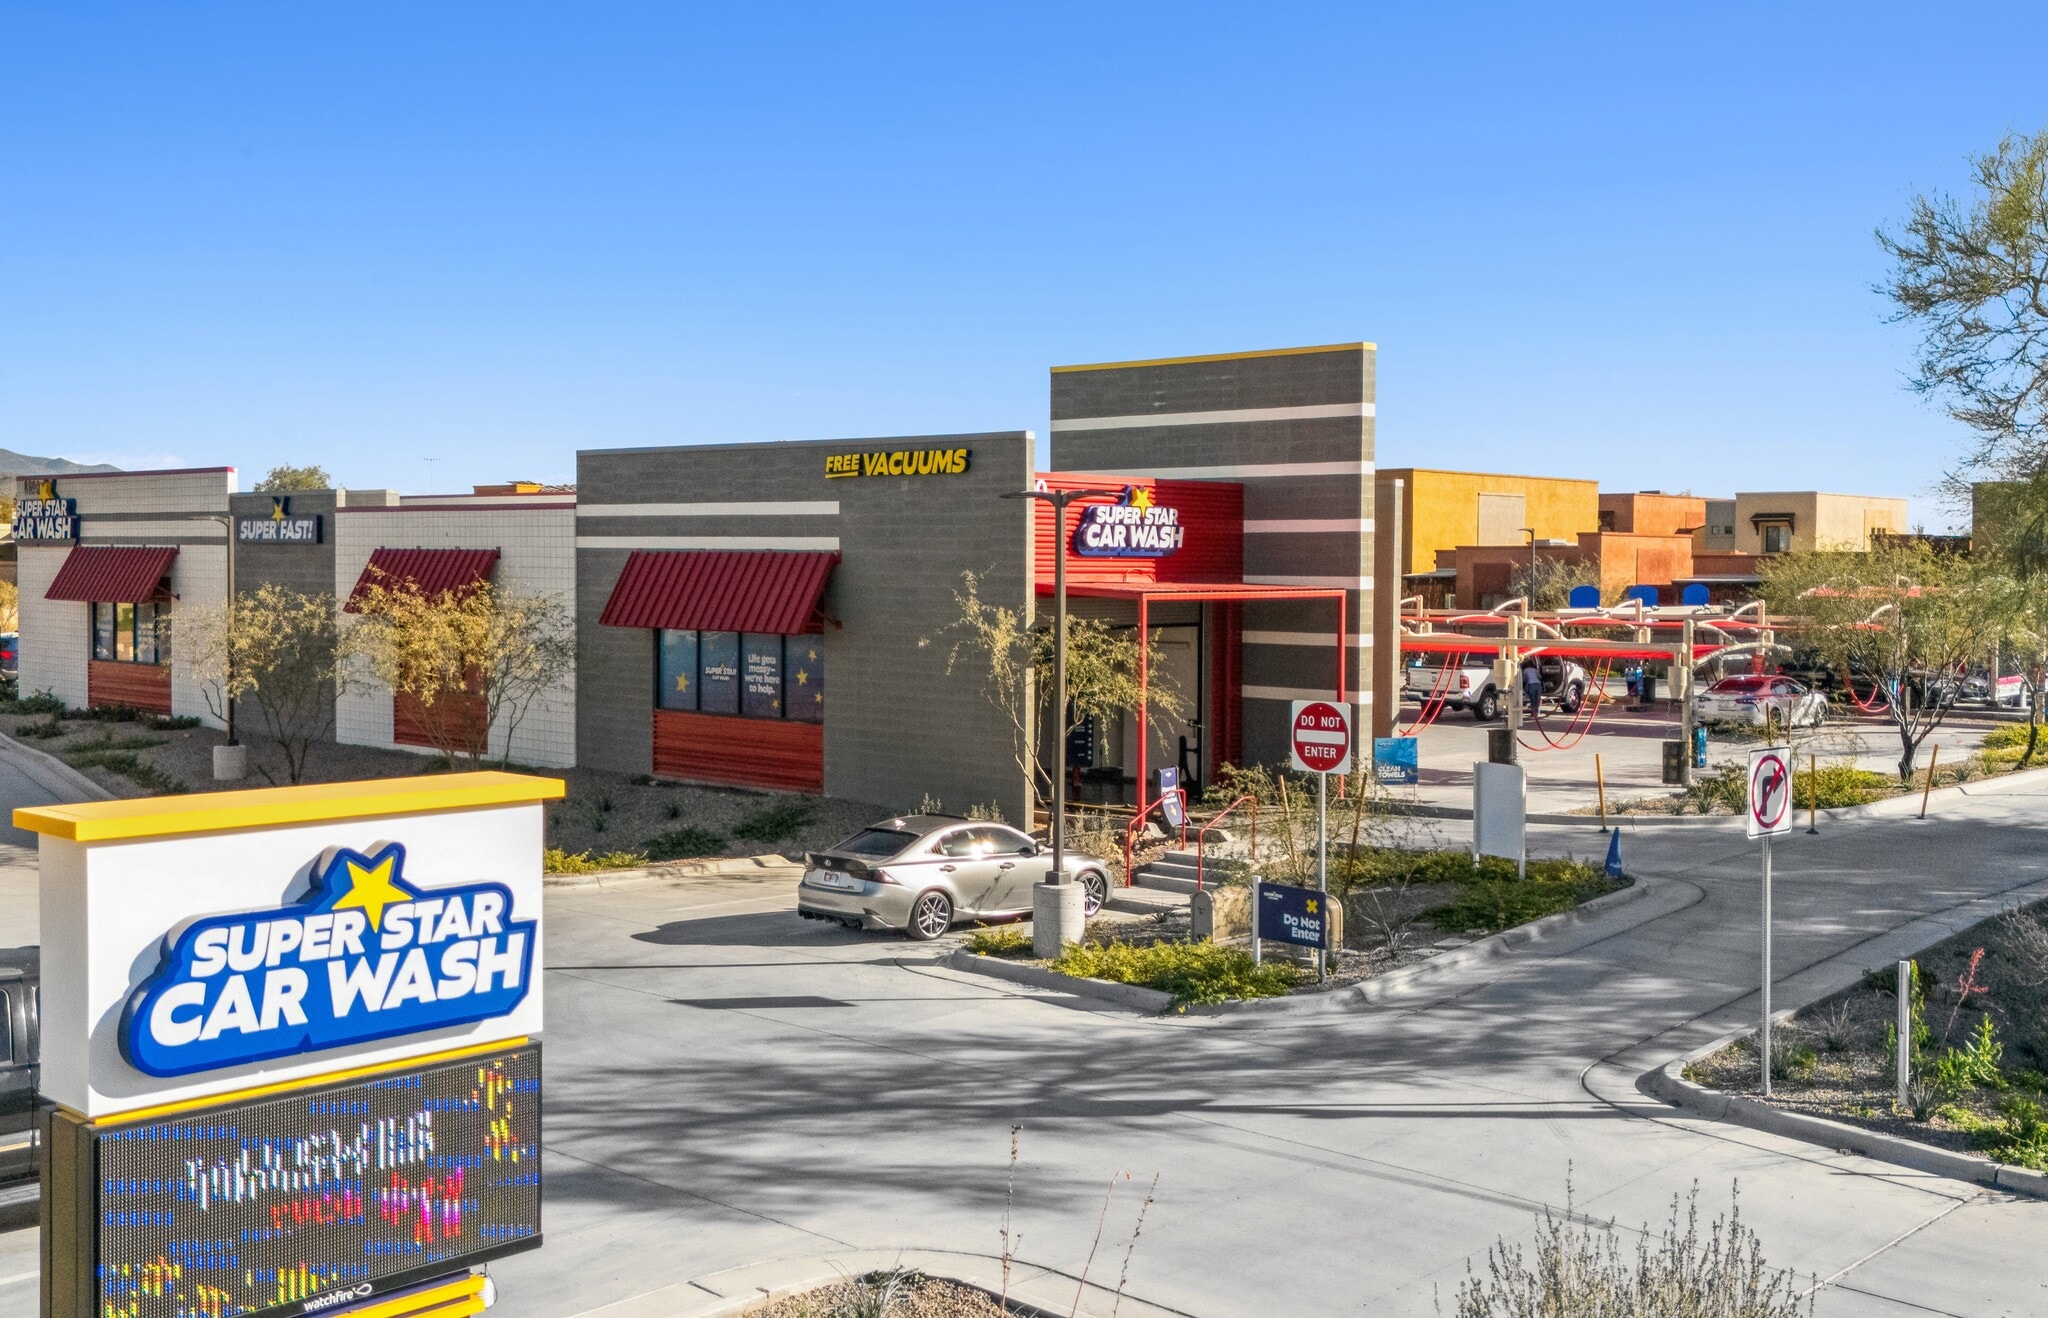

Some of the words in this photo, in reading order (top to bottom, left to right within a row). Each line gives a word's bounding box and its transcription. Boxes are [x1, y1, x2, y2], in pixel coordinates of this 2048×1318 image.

[825, 453, 860, 472] FREE
[863, 449, 967, 476] VACUUMS
[16, 499, 43, 517] SUPER
[45, 499, 67, 516] STAR
[1096, 505, 1140, 525] SUPER
[1144, 506, 1179, 525] STAR
[11, 516, 34, 539] CAR
[36, 517, 72, 539] WASH
[240, 520, 277, 539] SUPER
[280, 520, 314, 539] FAST!
[1086, 523, 1126, 548] CAR
[1131, 524, 1184, 549] WASH
[748, 653, 761, 663] Life
[761, 655, 777, 665] gets
[704, 666, 722, 675] SUPER
[723, 667, 737, 675] STAR
[763, 674, 780, 684] here
[749, 684, 757, 693] to
[757, 683, 775, 695] help.
[1301, 715, 1315, 727] DO
[1321, 716, 1341, 728] NOT
[1304, 746, 1337, 759] ENTER
[1377, 764, 1401, 772] CLEAN
[1283, 913, 1299, 926] Do
[1300, 916, 1321, 930] Not
[190, 910, 366, 978] SUPER
[380, 892, 504, 950] STAR
[1291, 926, 1320, 941] Enter
[149, 966, 309, 1047] CAR
[327, 932, 525, 1019] WASH
[303, 1290, 354, 1312] watchfire
